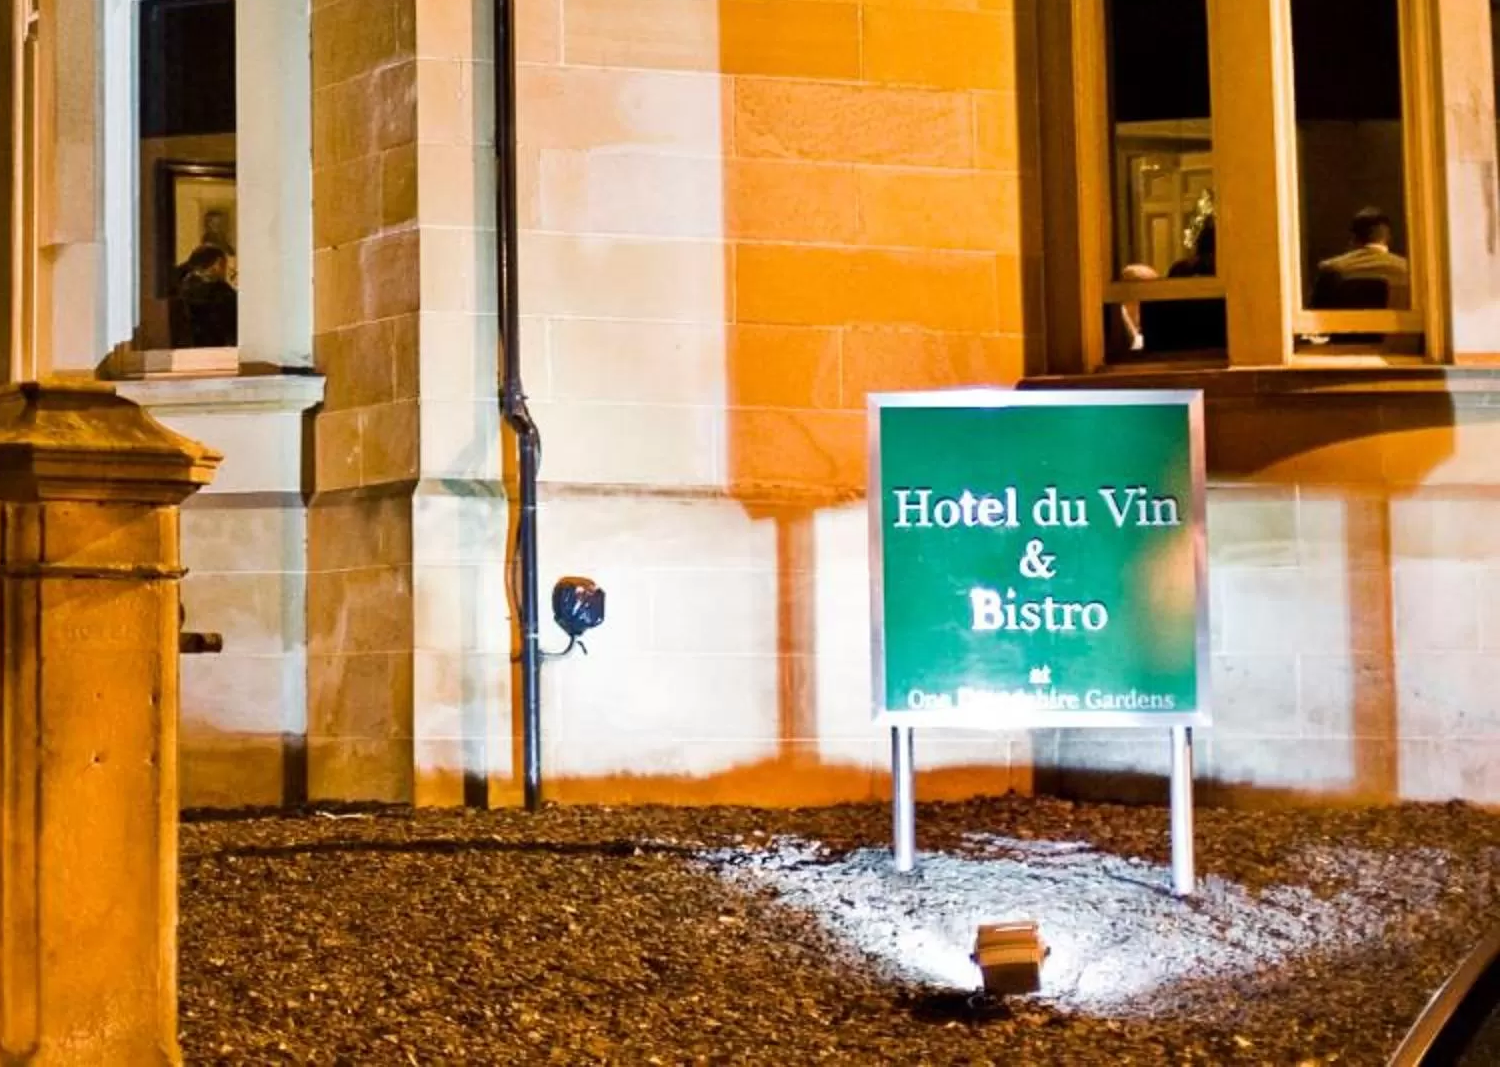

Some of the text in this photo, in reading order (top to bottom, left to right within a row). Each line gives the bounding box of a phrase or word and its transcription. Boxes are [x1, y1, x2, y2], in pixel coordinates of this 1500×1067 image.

[893, 486, 1181, 528] Hotel du Vin
[1019, 538, 1057, 579] &
[970, 587, 1108, 631] Bistro
[1085, 687, 1176, 710] Gardens
